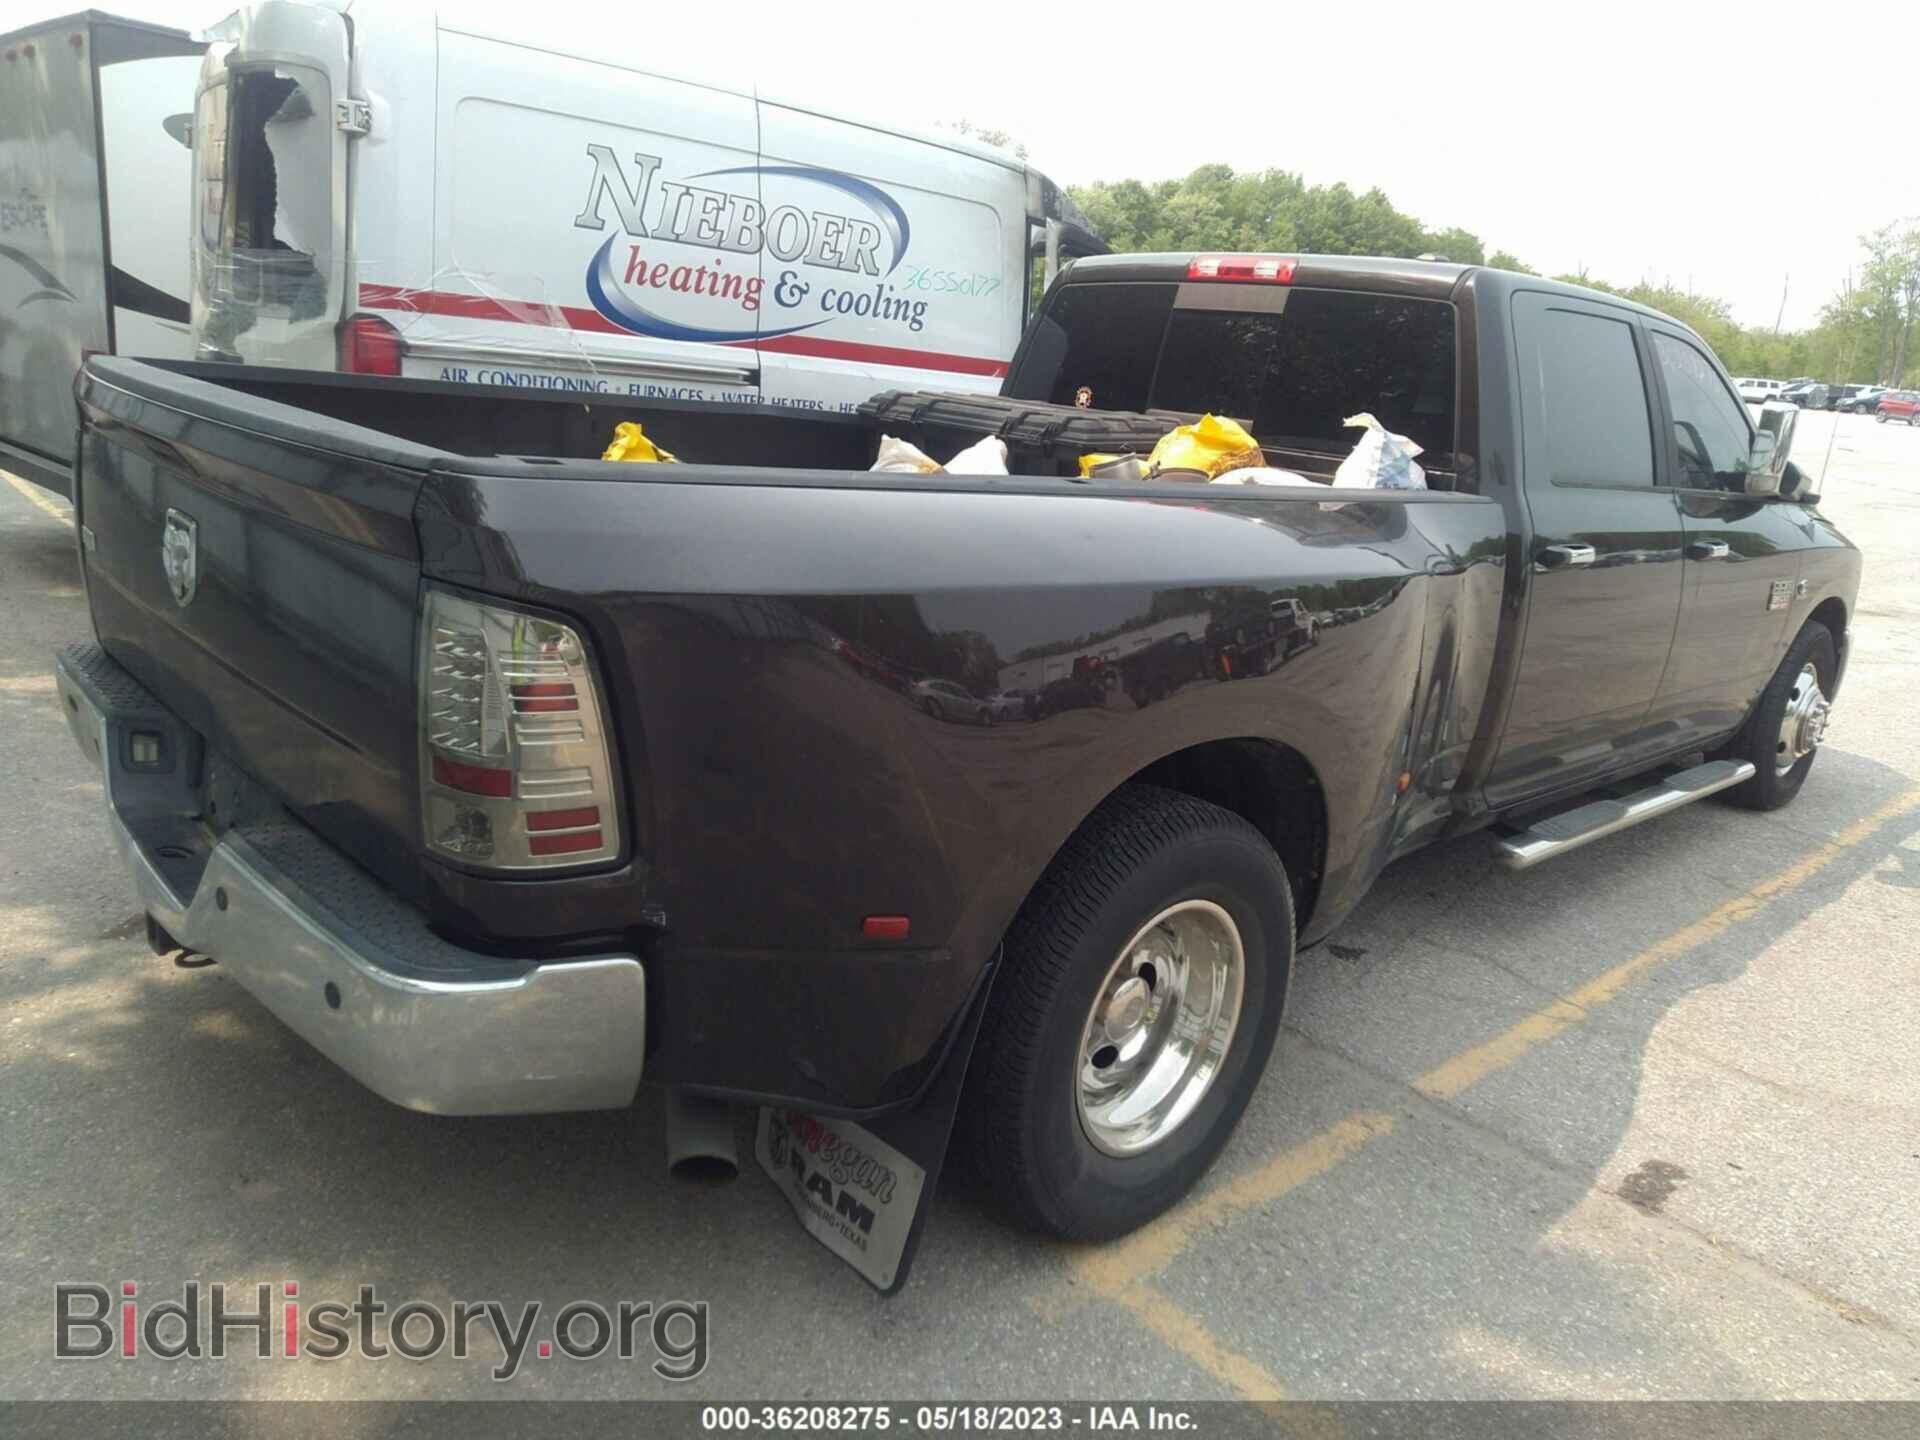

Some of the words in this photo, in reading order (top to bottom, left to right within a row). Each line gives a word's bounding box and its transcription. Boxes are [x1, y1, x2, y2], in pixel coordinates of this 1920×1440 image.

[574, 143, 881, 277] NIEBOER
[624, 244, 765, 312] heating
[774, 270, 810, 308] &
[820, 284, 928, 332] cooling
[440, 366, 468, 384] AIR
[477, 369, 608, 394] CONDITIONING
